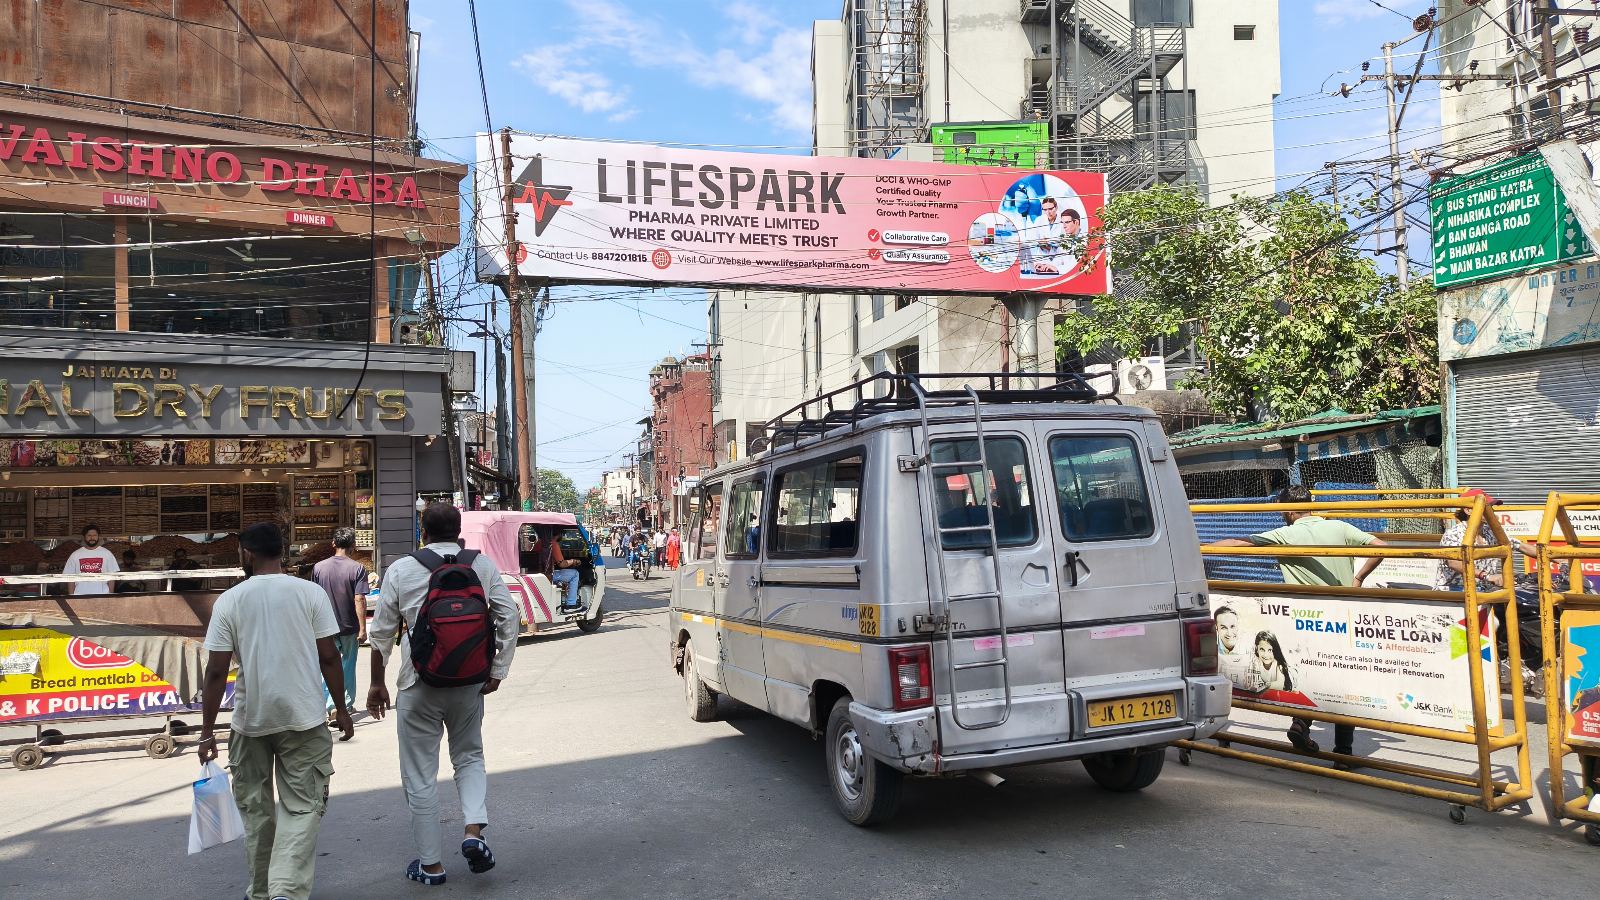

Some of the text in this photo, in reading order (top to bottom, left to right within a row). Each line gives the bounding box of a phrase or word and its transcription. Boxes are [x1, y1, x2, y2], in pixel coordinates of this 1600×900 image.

[0, 124, 426, 209] VAISHNO DHABA
[598, 158, 846, 214] LIFESPARK
[899, 176, 905, 184] &
[907, 177, 952, 187] WHO-GMP
[113, 194, 147, 207] LUNCH
[876, 186, 942, 199] Certified Quality
[1447, 179, 1534, 212] BUS STAND KATRA
[928, 201, 958, 209] Pharma
[1448, 193, 1540, 228] NIHARIKA COMPLEX
[293, 213, 326, 225] DINNER
[629, 210, 819, 231] PHARMA PRIVATE LIMITED
[876, 209, 940, 219] Growth Partner.
[1448, 213, 1531, 244] BAN GANGA ROAD
[609, 226, 838, 248] WHERE QUALITY MEETS TRUST
[885, 232, 947, 242] Collaborative Care
[537, 249, 648, 263] Contact Us 8847201815
[886, 251, 948, 261] Quality Assurance
[1449, 240, 1488, 260] BHAWAN
[677, 254, 870, 270] Visit Our Website www.lifesparkpharma.com
[1450, 244, 1545, 275] MAIN BAZAR KATRA
[1529, 267, 1577, 290] WATER
[1566, 296, 1574, 308] 7
[62, 364, 177, 380] JAI MATA DI
[0, 379, 407, 420] AL DRY FRUITS
[1260, 604, 1323, 620] LIVE your
[861, 620, 876, 635] 2128
[1295, 619, 1347, 634] DREAM
[1355, 614, 1381, 626] J&K
[1386, 615, 1418, 628] Bank
[1355, 627, 1443, 644] HOME LOAN
[1355, 641, 1436, 655] Easy & Affordable...
[1317, 651, 1343, 661] Finance
[1359, 654, 1373, 663] also
[1375, 655, 1383, 664] be
[1385, 656, 1410, 667] availed
[1411, 659, 1421, 668] for
[1300, 658, 1445, 680] Addition Alteration Repair Renovation
[31, 676, 76, 690] Bread
[81, 672, 136, 687] matlab
[0, 690, 183, 716] & K POLICE (KA
[1101, 699, 1172, 722] JK 12 2128
[1413, 702, 1431, 711] J&K
[1433, 705, 1453, 714] Bank
